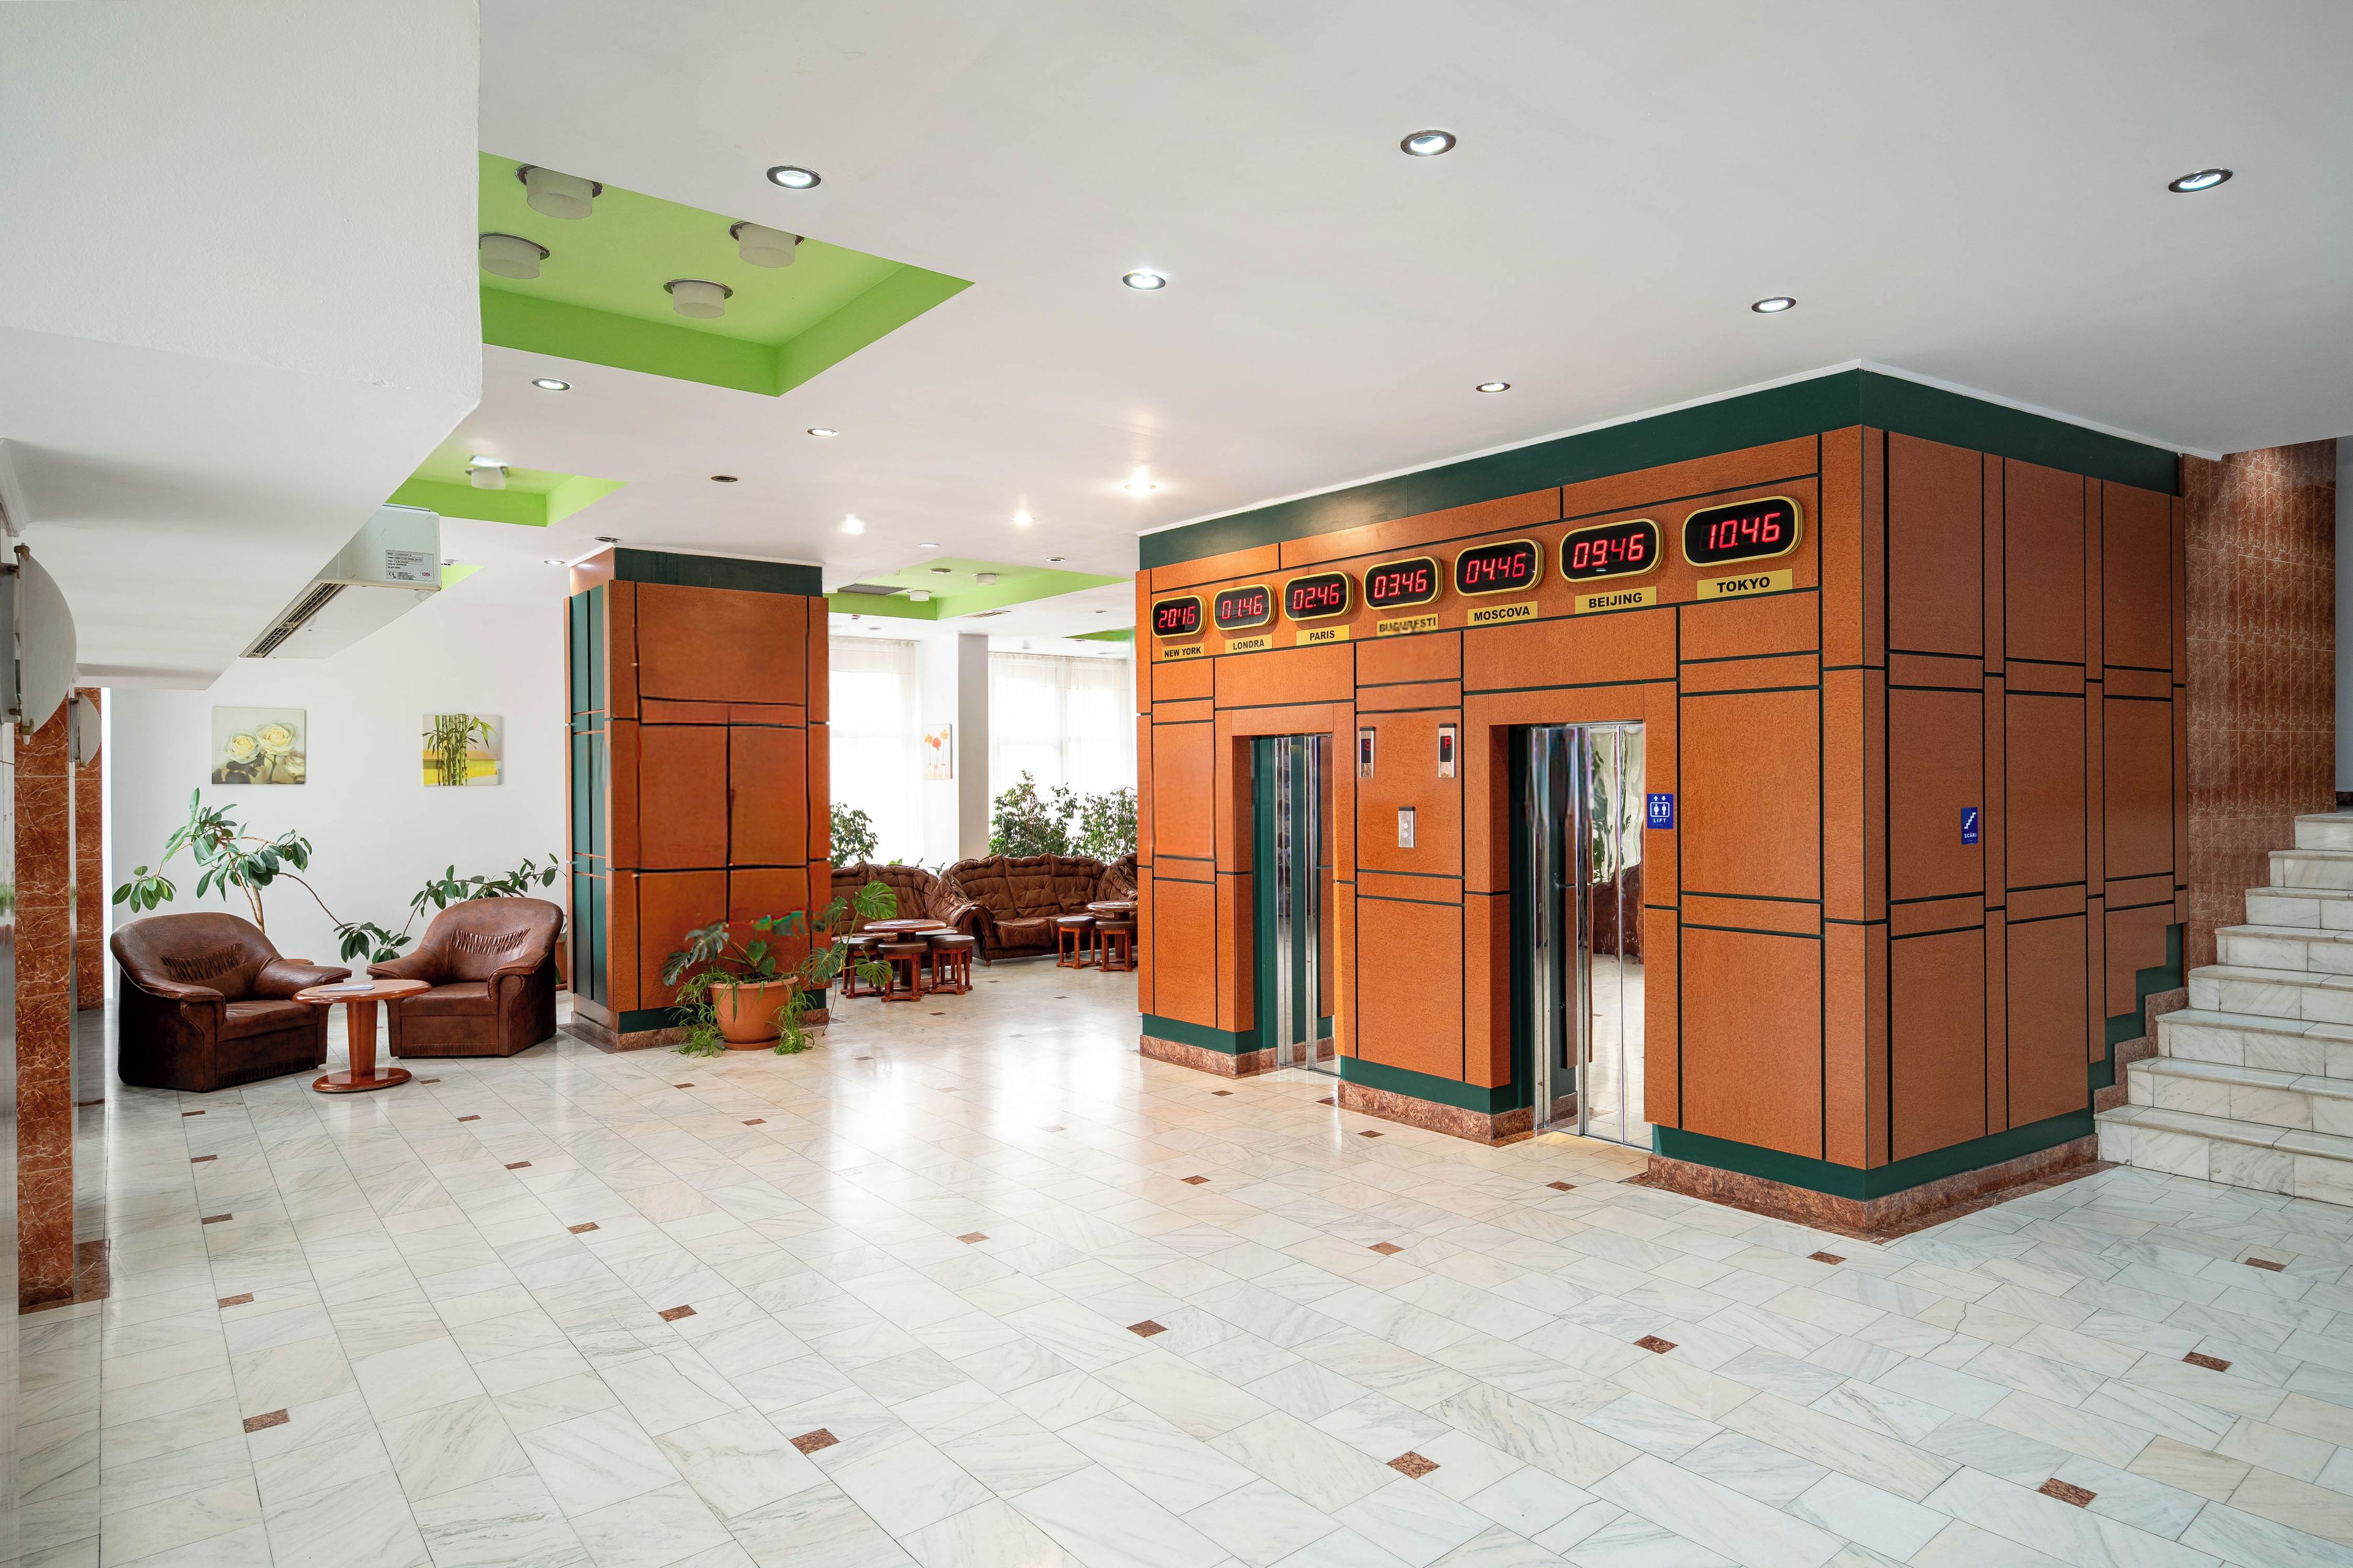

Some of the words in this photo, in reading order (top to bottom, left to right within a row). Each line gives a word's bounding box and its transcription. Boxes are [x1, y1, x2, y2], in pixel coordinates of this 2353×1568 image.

[1716, 576, 1770, 593] TOKYO
[1588, 592, 1643, 609] BEIJING
[1474, 606, 1531, 622] MOSCOVA
[1309, 630, 1335, 641] PARIS
[1233, 639, 1265, 650] LONDRA
[1164, 649, 1180, 657] NEW
[1181, 646, 1201, 656] YORK
[1445, 737, 1451, 748] P
